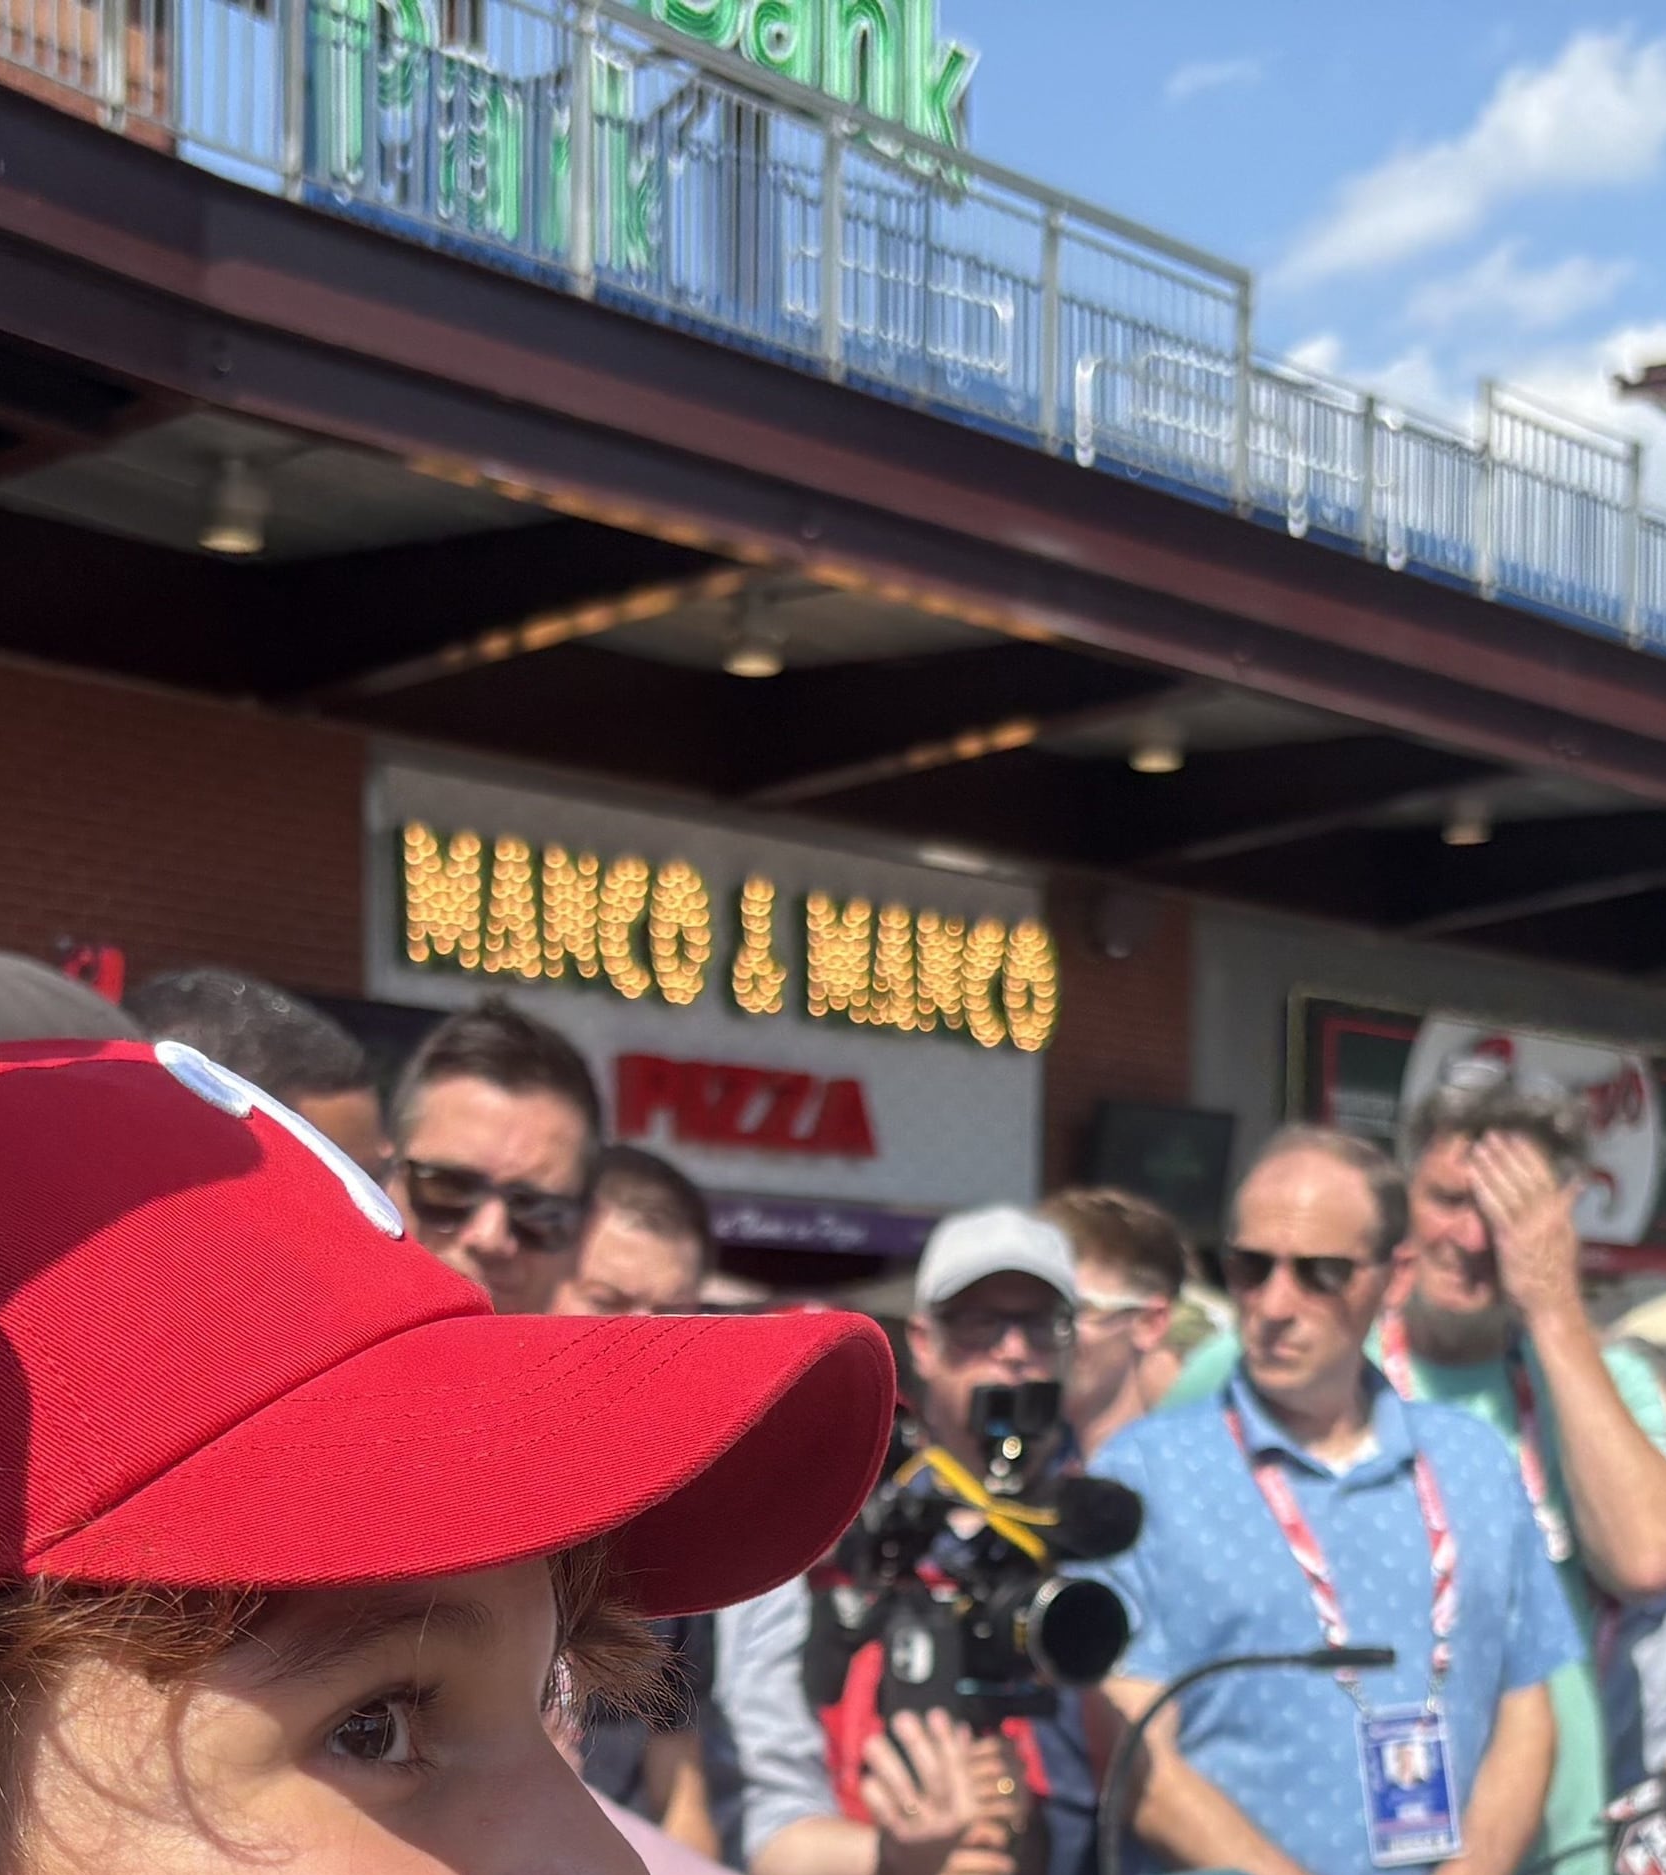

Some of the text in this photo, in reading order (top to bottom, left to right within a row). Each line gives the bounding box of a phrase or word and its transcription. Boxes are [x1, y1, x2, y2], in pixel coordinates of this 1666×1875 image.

[403, 820, 1060, 1053] MANCO & MANCO
[615, 1051, 878, 1159] PIZZA
